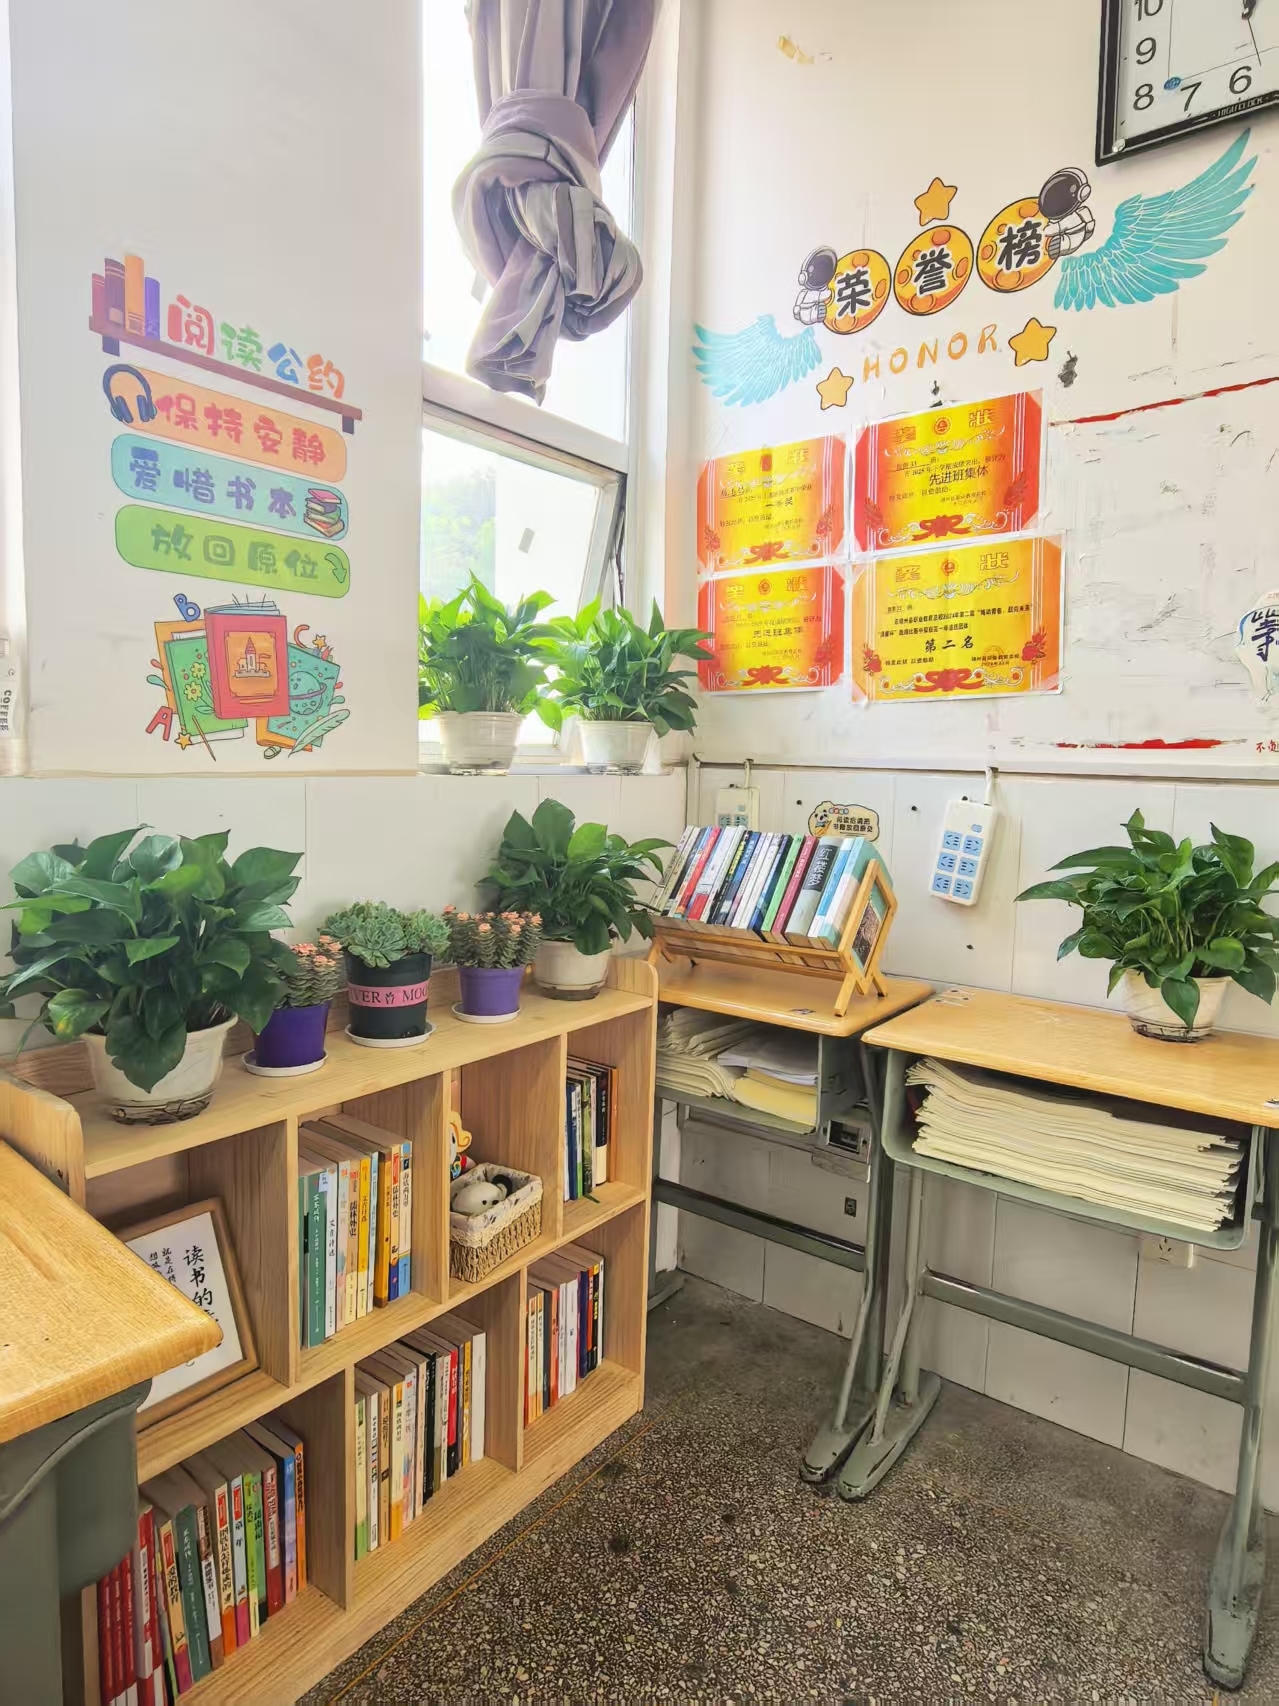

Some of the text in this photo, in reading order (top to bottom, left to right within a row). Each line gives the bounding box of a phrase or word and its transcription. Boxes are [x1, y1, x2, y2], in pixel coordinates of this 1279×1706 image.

[1136, 37, 1157, 65] 9
[1133, 83, 1154, 111] 8
[1180, 81, 1202, 112] 7
[1229, 65, 1252, 94] 6
[836, 220, 1042, 318] 荣誉榜
[167, 294, 345, 399] 阅读公约
[862, 324, 997, 383] HONOR
[155, 392, 326, 465] 保持安静
[129, 446, 296, 519] 爱惜书本
[151, 523, 318, 580] 放回原位
[925, 635, 974, 654] 第二名
[145, 706, 173, 741] A
